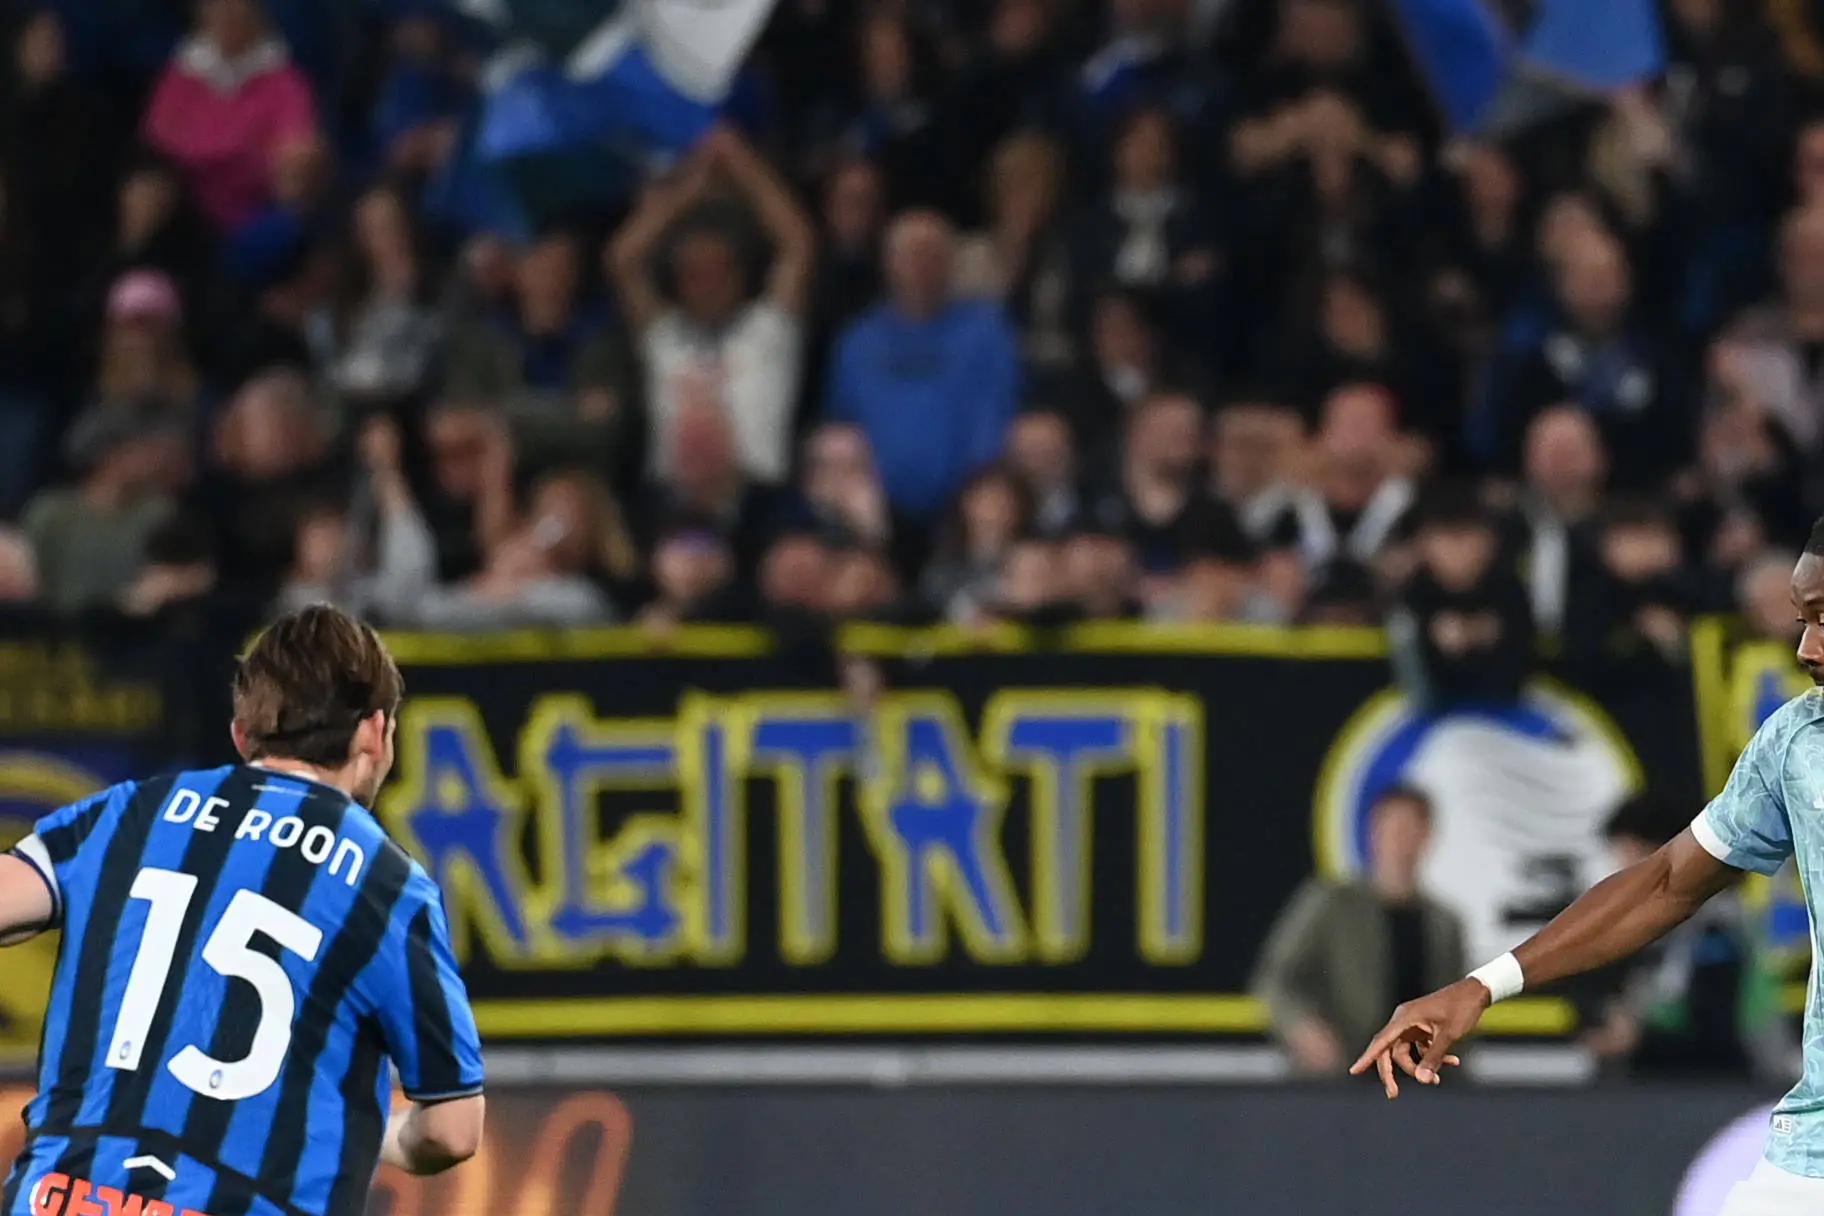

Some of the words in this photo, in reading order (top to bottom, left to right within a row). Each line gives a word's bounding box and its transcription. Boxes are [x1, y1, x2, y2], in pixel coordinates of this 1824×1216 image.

[163, 788, 230, 832] DE
[234, 808, 364, 887] ROON
[105, 868, 323, 1101] 15
